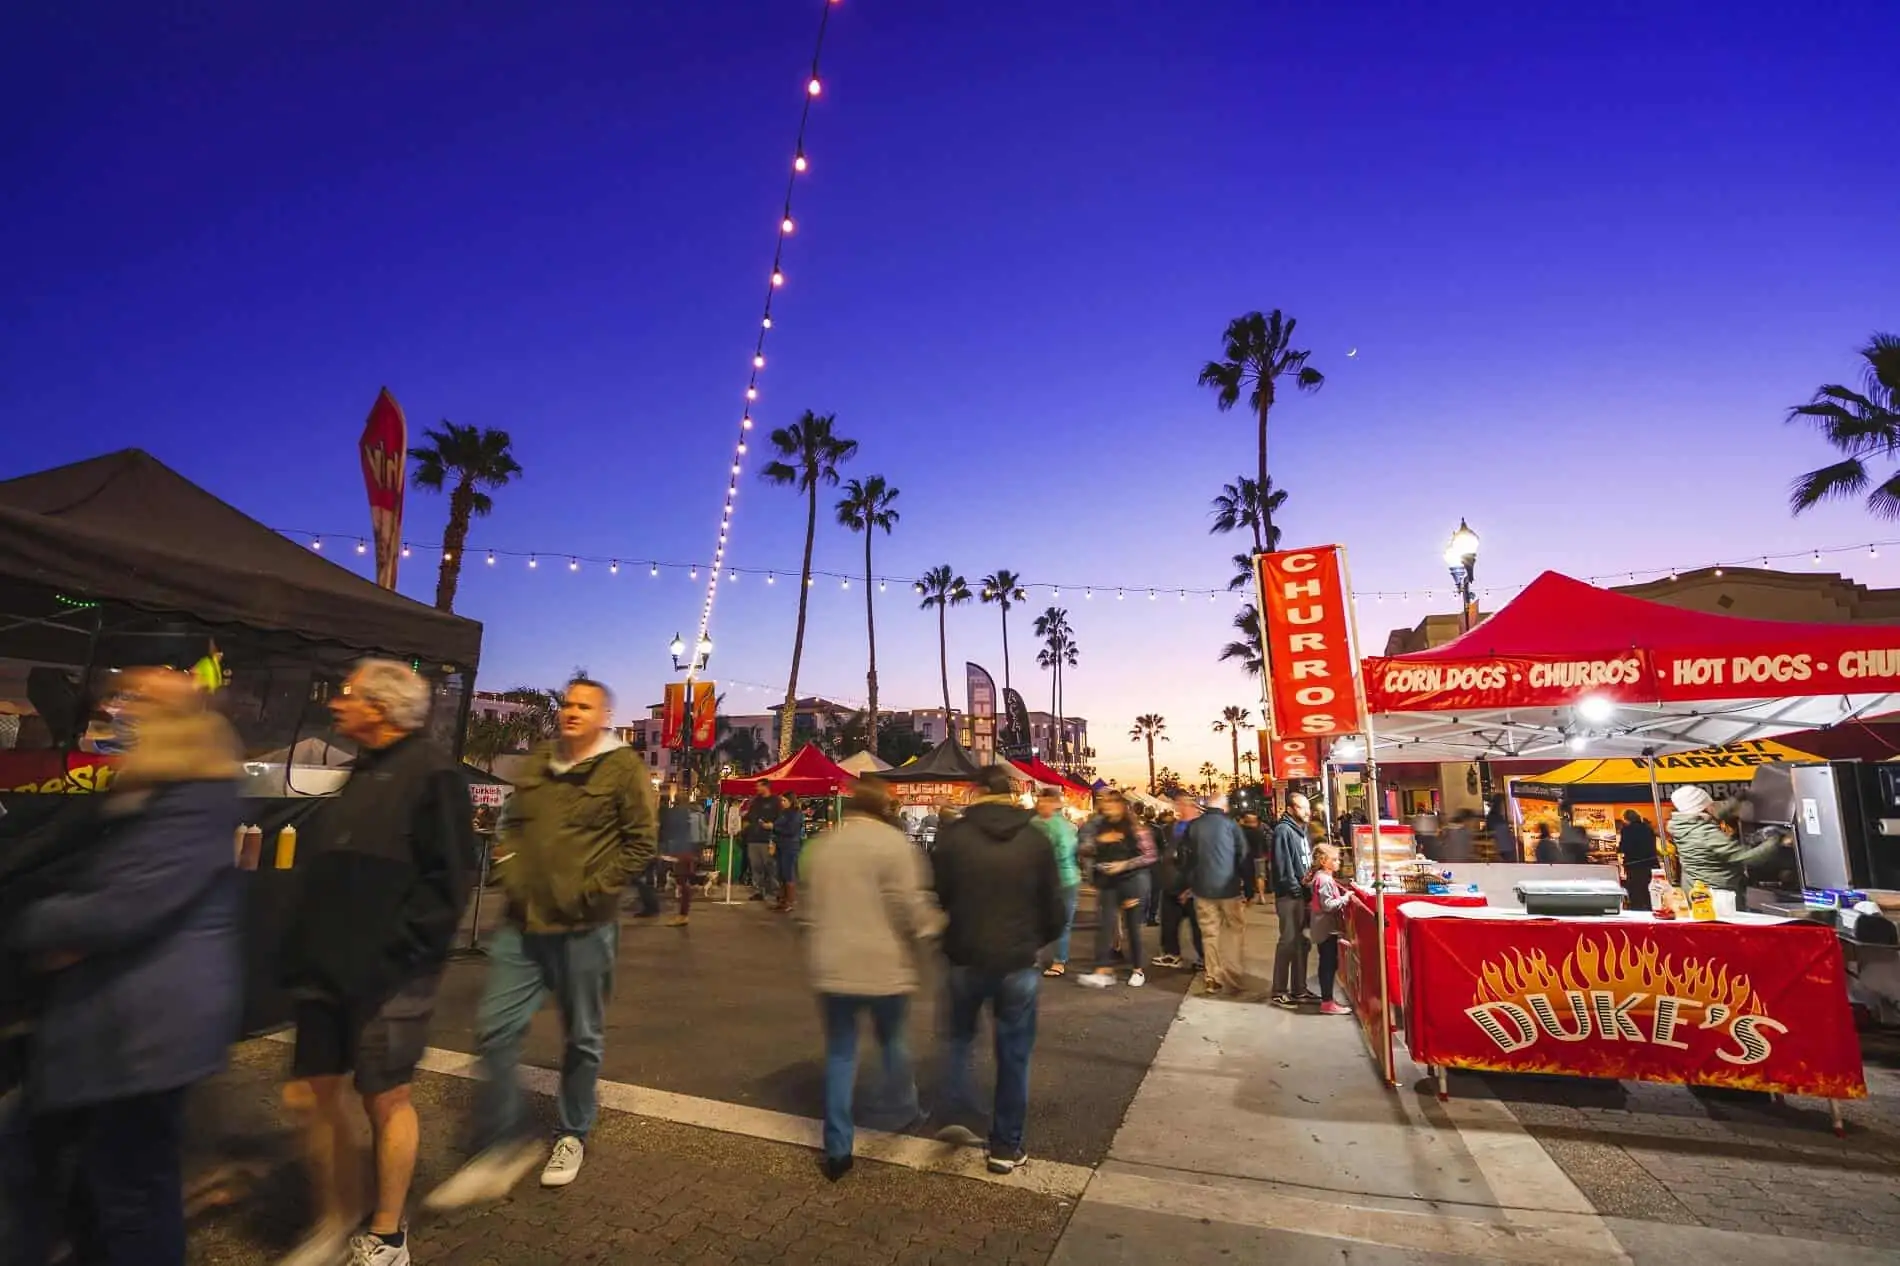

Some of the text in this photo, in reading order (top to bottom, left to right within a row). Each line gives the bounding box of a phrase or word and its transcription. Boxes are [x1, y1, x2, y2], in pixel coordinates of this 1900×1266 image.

[1281, 553, 1336, 734] CHURROS
[1384, 667, 1441, 693] CORN
[1446, 665, 1506, 691] DOGS
[1529, 658, 1640, 688] CHURROS
[1672, 658, 1726, 685] HOT
[1732, 654, 1812, 682] DOGS
[1283, 741, 1308, 777] OGS
[1631, 753, 1784, 768] MARKET
[895, 783, 953, 795] SUSHI
[1464, 990, 1789, 1065] DUKE'S
